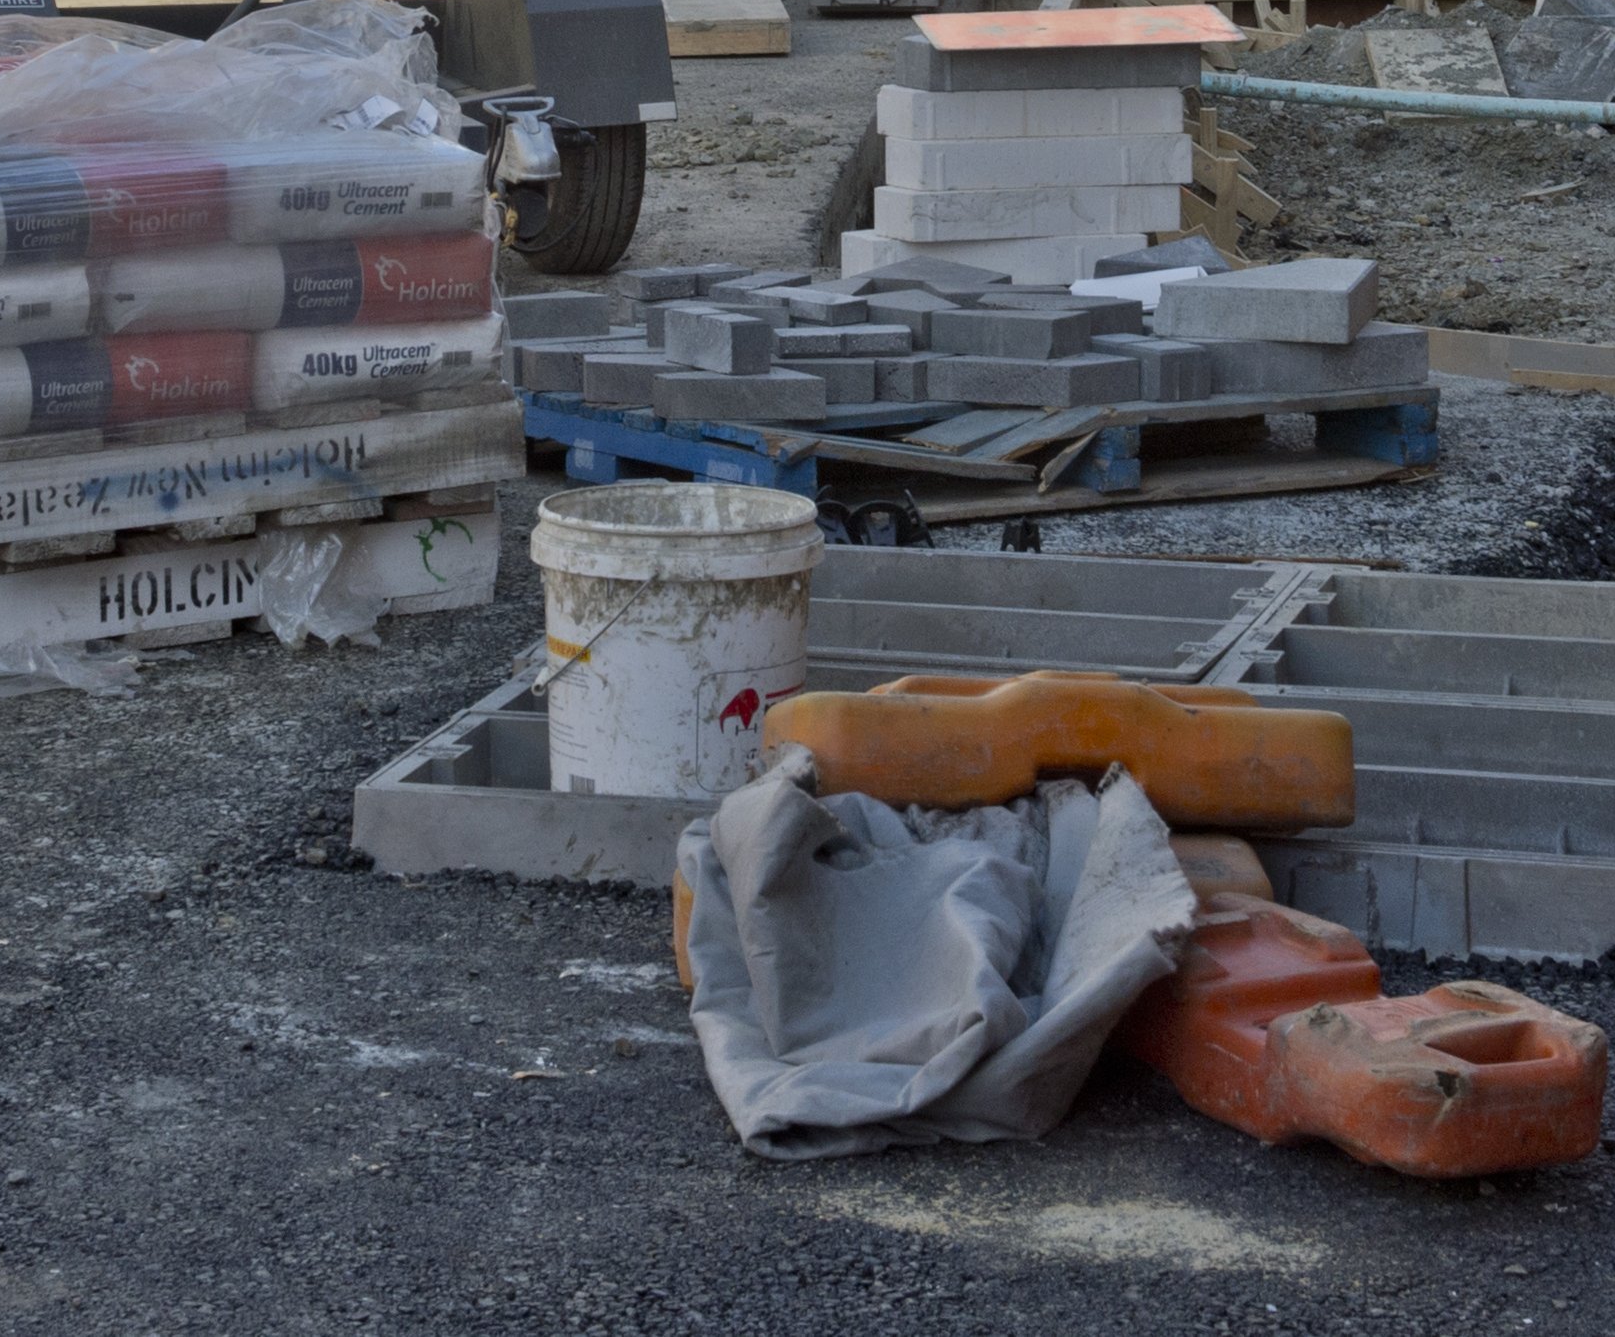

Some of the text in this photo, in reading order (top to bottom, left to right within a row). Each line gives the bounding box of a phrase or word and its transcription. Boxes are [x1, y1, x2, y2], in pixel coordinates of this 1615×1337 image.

[343, 199, 406, 215] Cement
[127, 210, 209, 234] Holcim
[21, 232, 77, 249] Cement
[398, 277, 474, 303] Holcim
[297, 293, 350, 309] Cement
[302, 352, 358, 377] 40kg
[370, 360, 430, 379] Cement
[40, 380, 104, 398] Ultracem
[150, 378, 230, 402] Holcim
